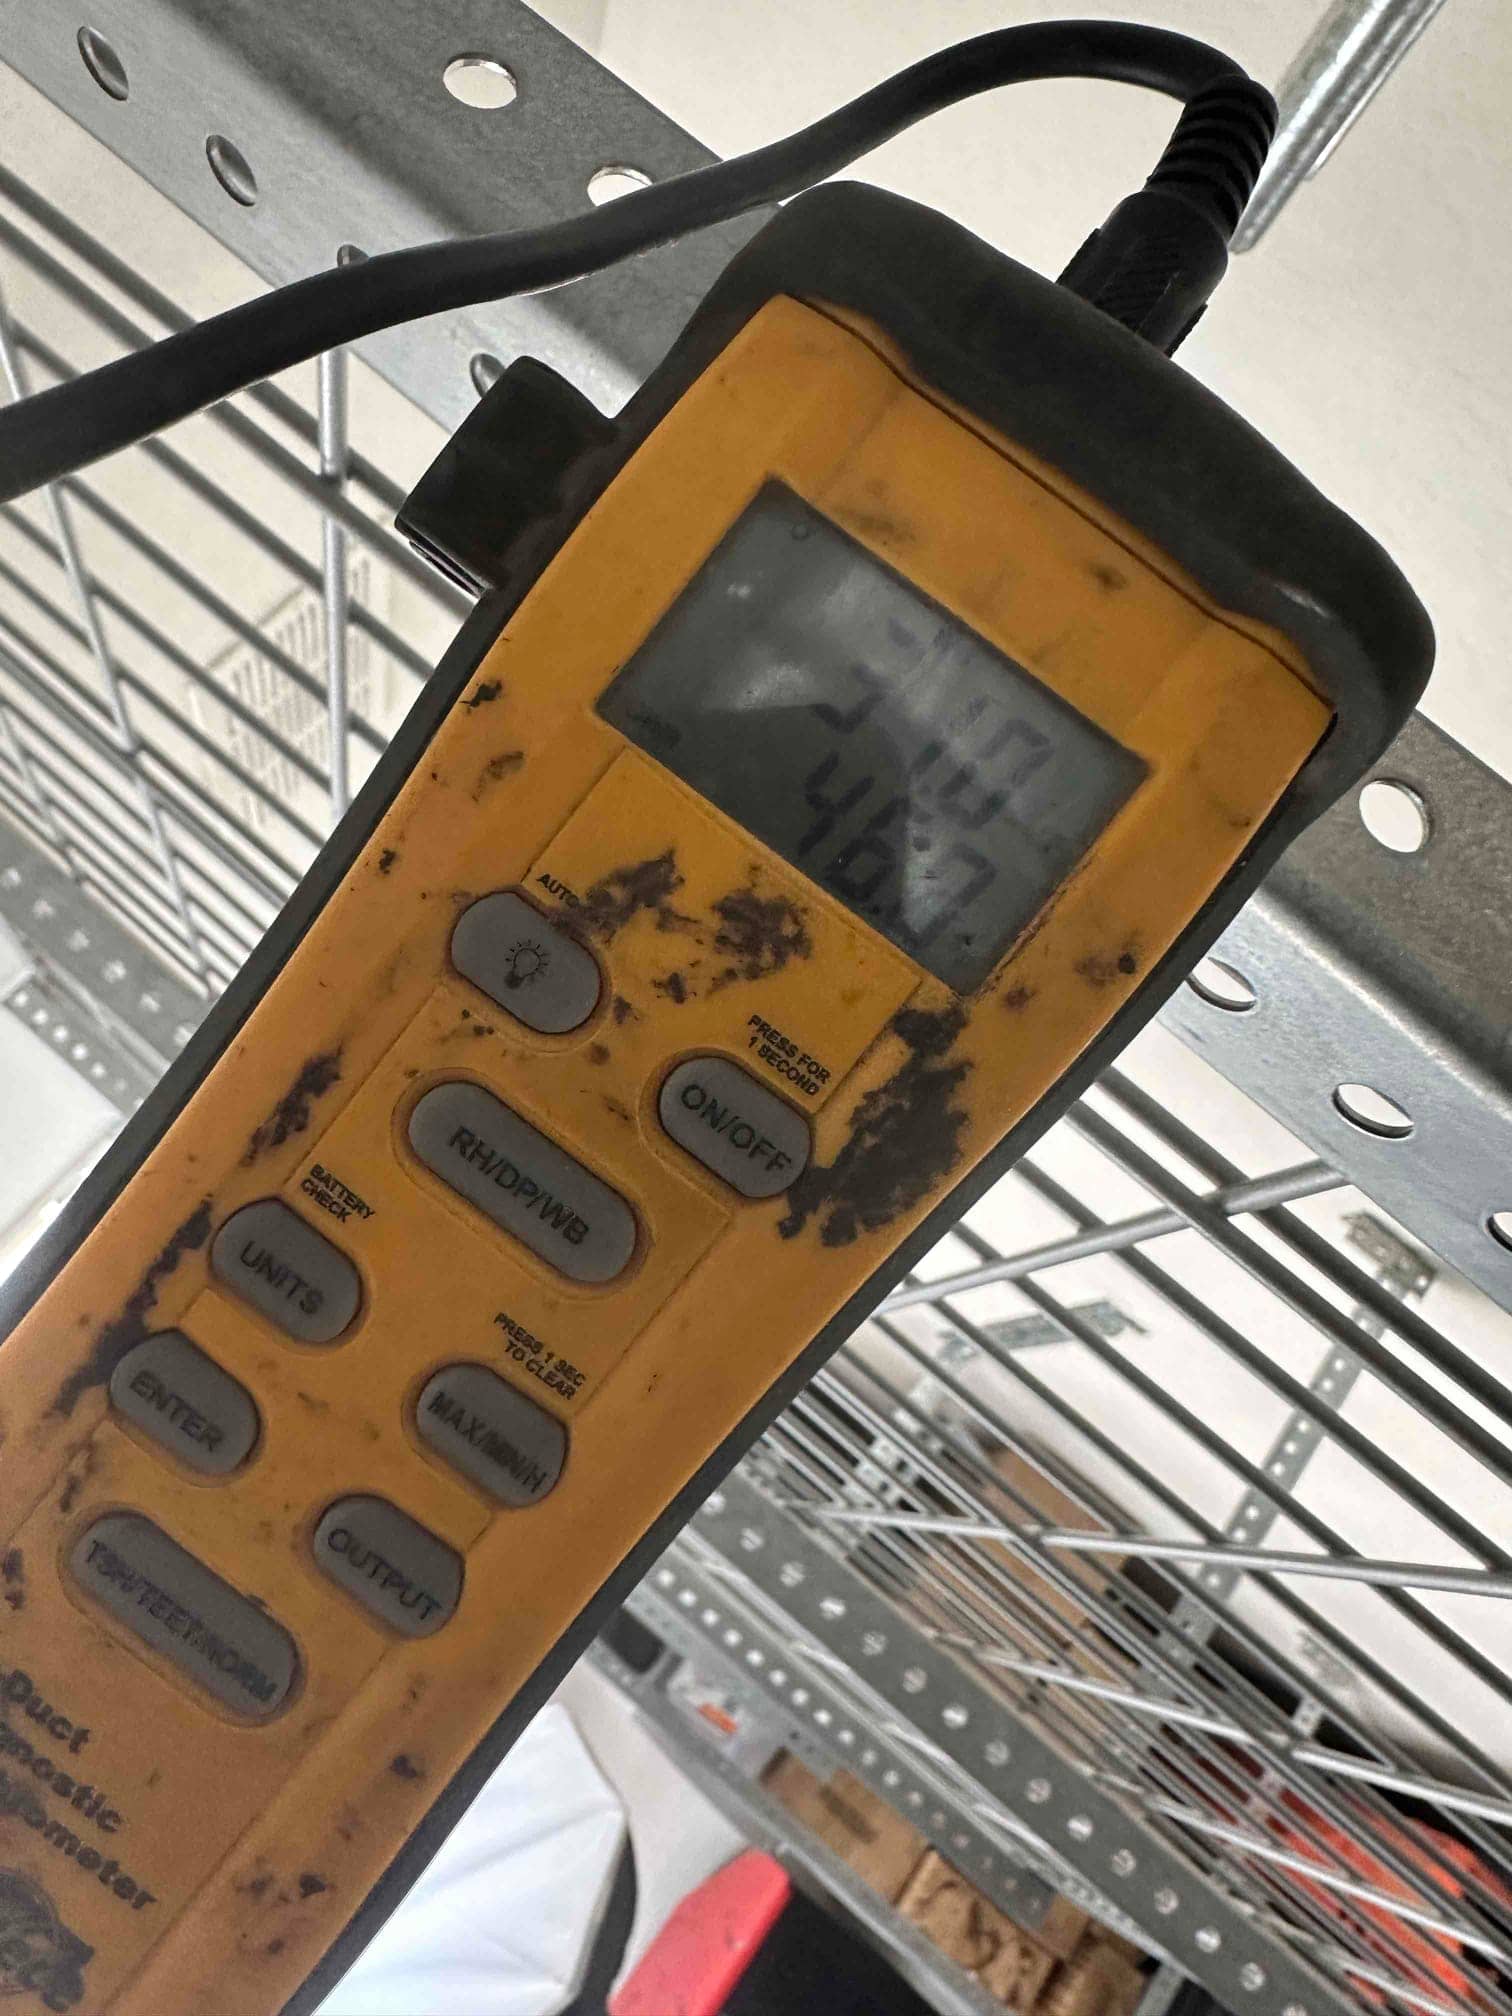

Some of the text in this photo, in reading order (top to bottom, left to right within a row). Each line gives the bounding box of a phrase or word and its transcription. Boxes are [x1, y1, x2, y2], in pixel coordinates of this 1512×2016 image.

[748, 1014, 831, 1085] PRESS FOR
[748, 1036, 820, 1096] 1 SECOND
[680, 1083, 792, 1172] ON/OFF
[300, 1179, 352, 1224] CHECK
[310, 1163, 376, 1220] BATTERY
[449, 1126, 590, 1246] RH/DP/WB
[240, 1240, 323, 1316] UNITS
[493, 1312, 587, 1386] PRESS 1 SEC
[505, 1340, 577, 1400] TO CLEAR
[129, 1369, 223, 1453] ENTER
[326, 1527, 442, 1620] OUTPUT
